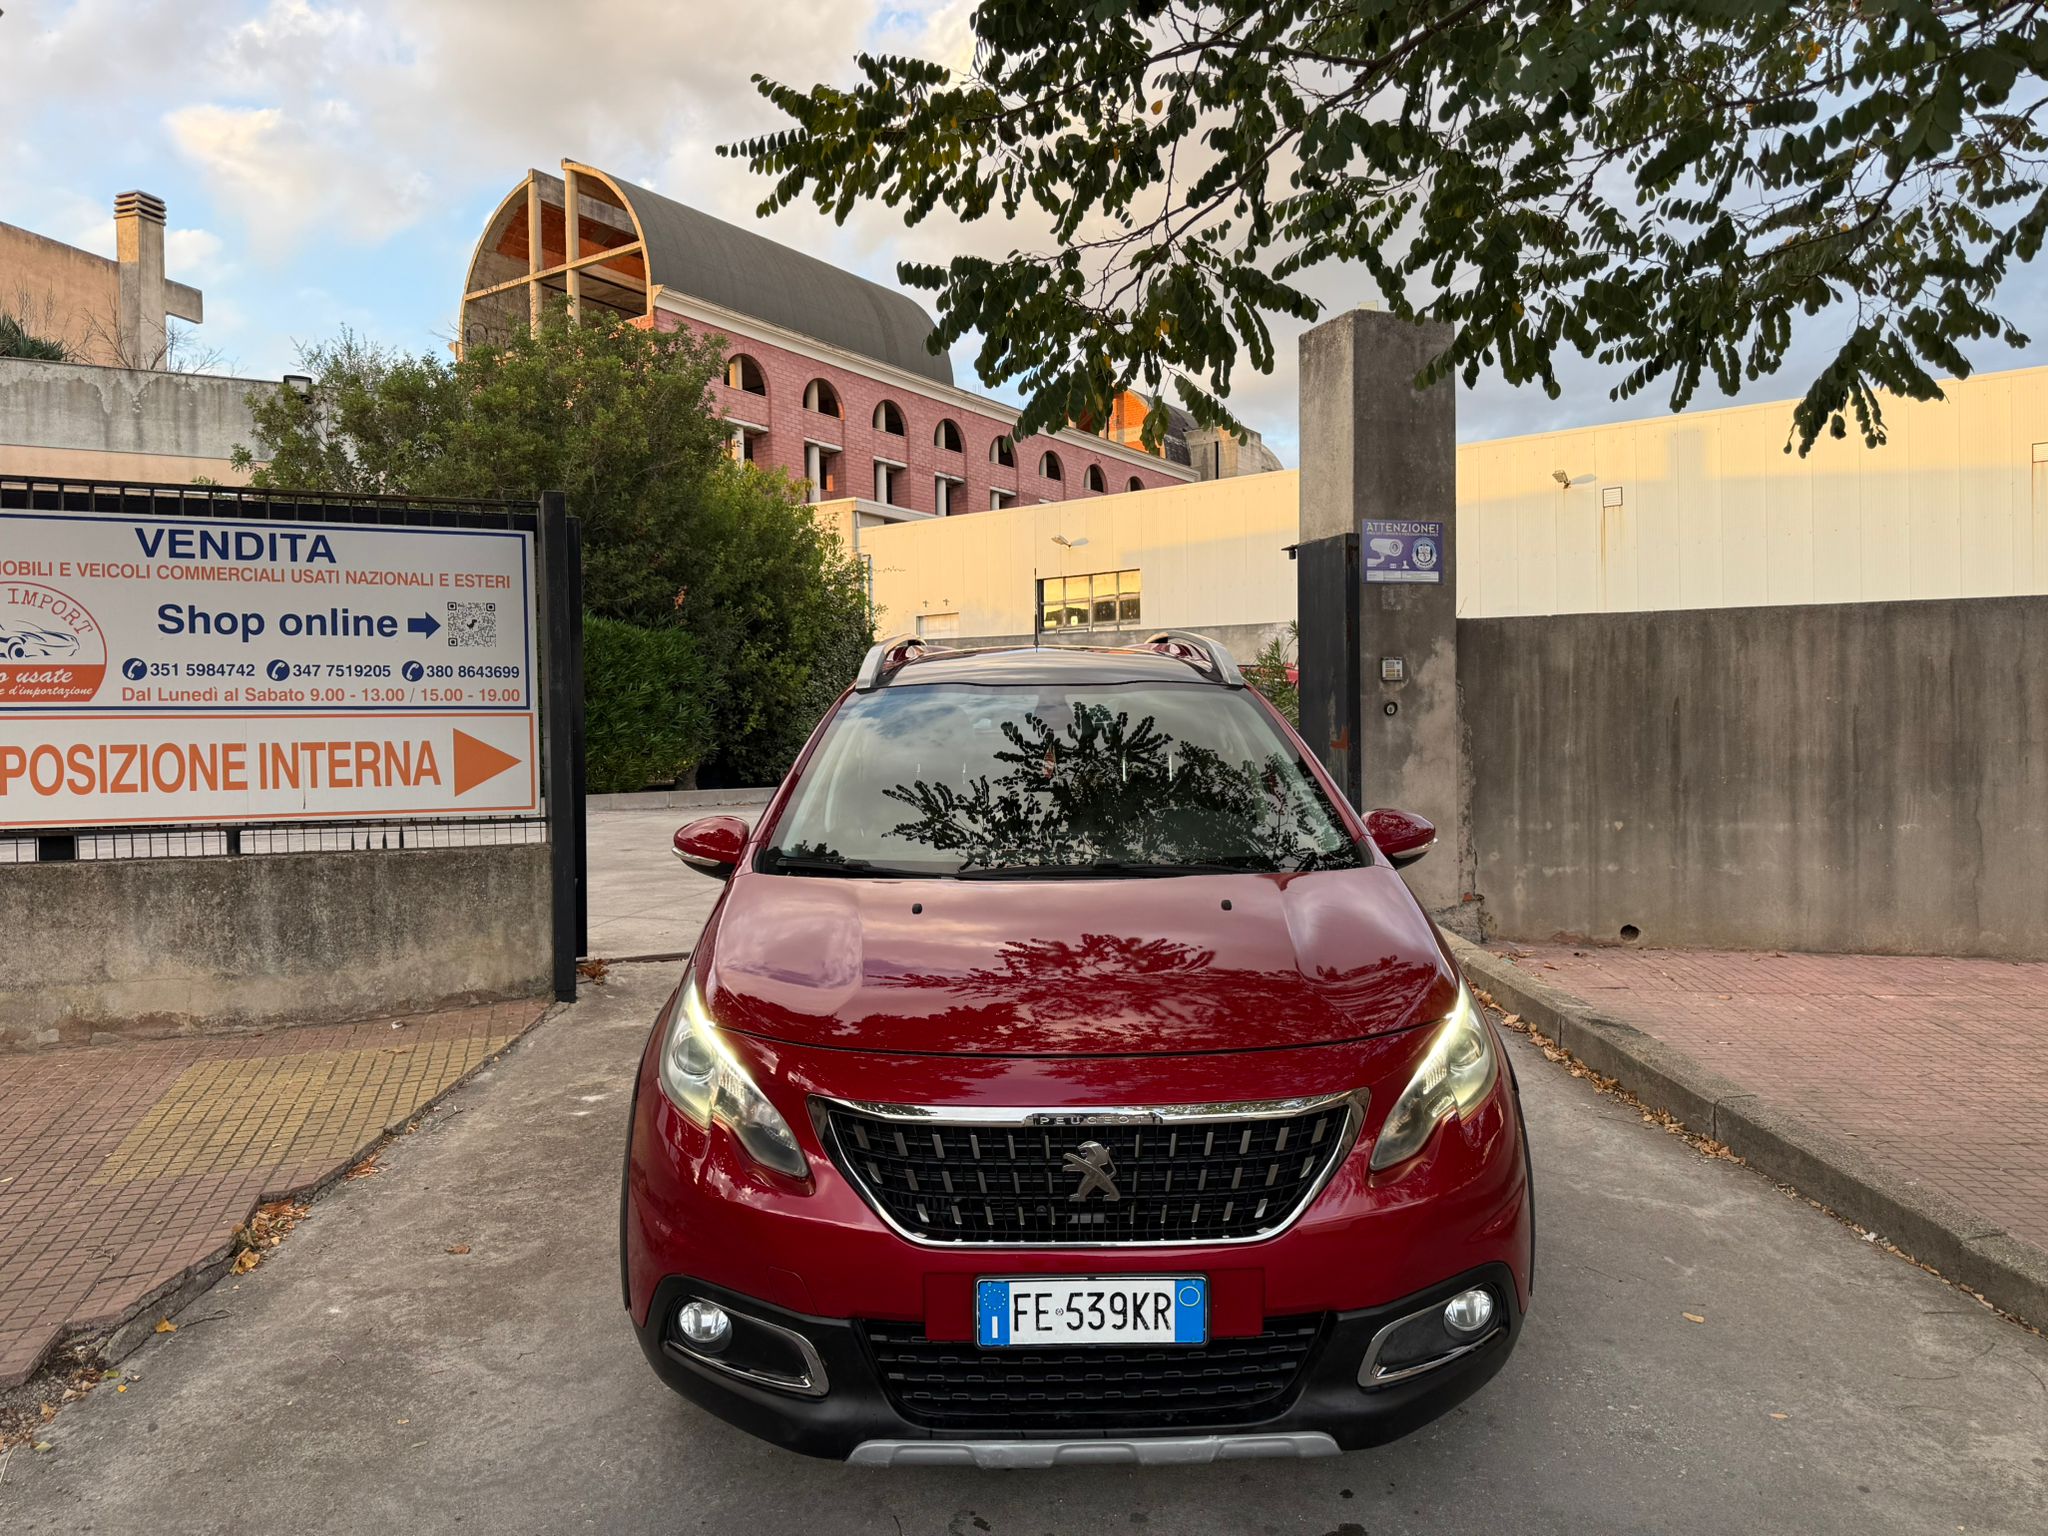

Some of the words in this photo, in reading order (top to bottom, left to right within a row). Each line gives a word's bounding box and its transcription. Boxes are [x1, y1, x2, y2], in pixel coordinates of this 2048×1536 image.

[1367, 522, 1439, 534] ATTENZIONE!
[135, 528, 337, 564] VENDITA
[0, 560, 53, 577] OBILI
[60, 561, 72, 577] E
[77, 562, 151, 579] VEICOLI
[157, 564, 285, 583] COMMERCIALI
[291, 568, 340, 585] USATI
[345, 570, 434, 587] NAZIONALI
[439, 573, 450, 588] E
[454, 573, 511, 589] ESTERI
[7, 588, 94, 634] IMPORT
[157, 603, 265, 643] Shop
[279, 608, 398, 637] online
[16, 668, 73, 684] usate
[150, 663, 179, 677] 351
[186, 663, 256, 677] 5984742
[292, 664, 321, 677] 347
[326, 664, 391, 678] 7519205
[426, 665, 454, 678] 380
[458, 665, 520, 679] 8643699
[8, 684, 94, 698] d'importazione
[122, 687, 151, 702] Dal
[158, 686, 218, 702] Lunedì
[224, 687, 239, 702] al
[245, 687, 306, 702] Sabato
[310, 688, 345, 702] 9.00
[361, 688, 405, 702] 13.00
[420, 688, 463, 702] 15.00
[478, 688, 521, 702] 19.00
[0, 742, 248, 797] POSIZIONE
[259, 740, 442, 790] INTERNA
[1040, 1115, 1145, 1125] PEUGEOT
